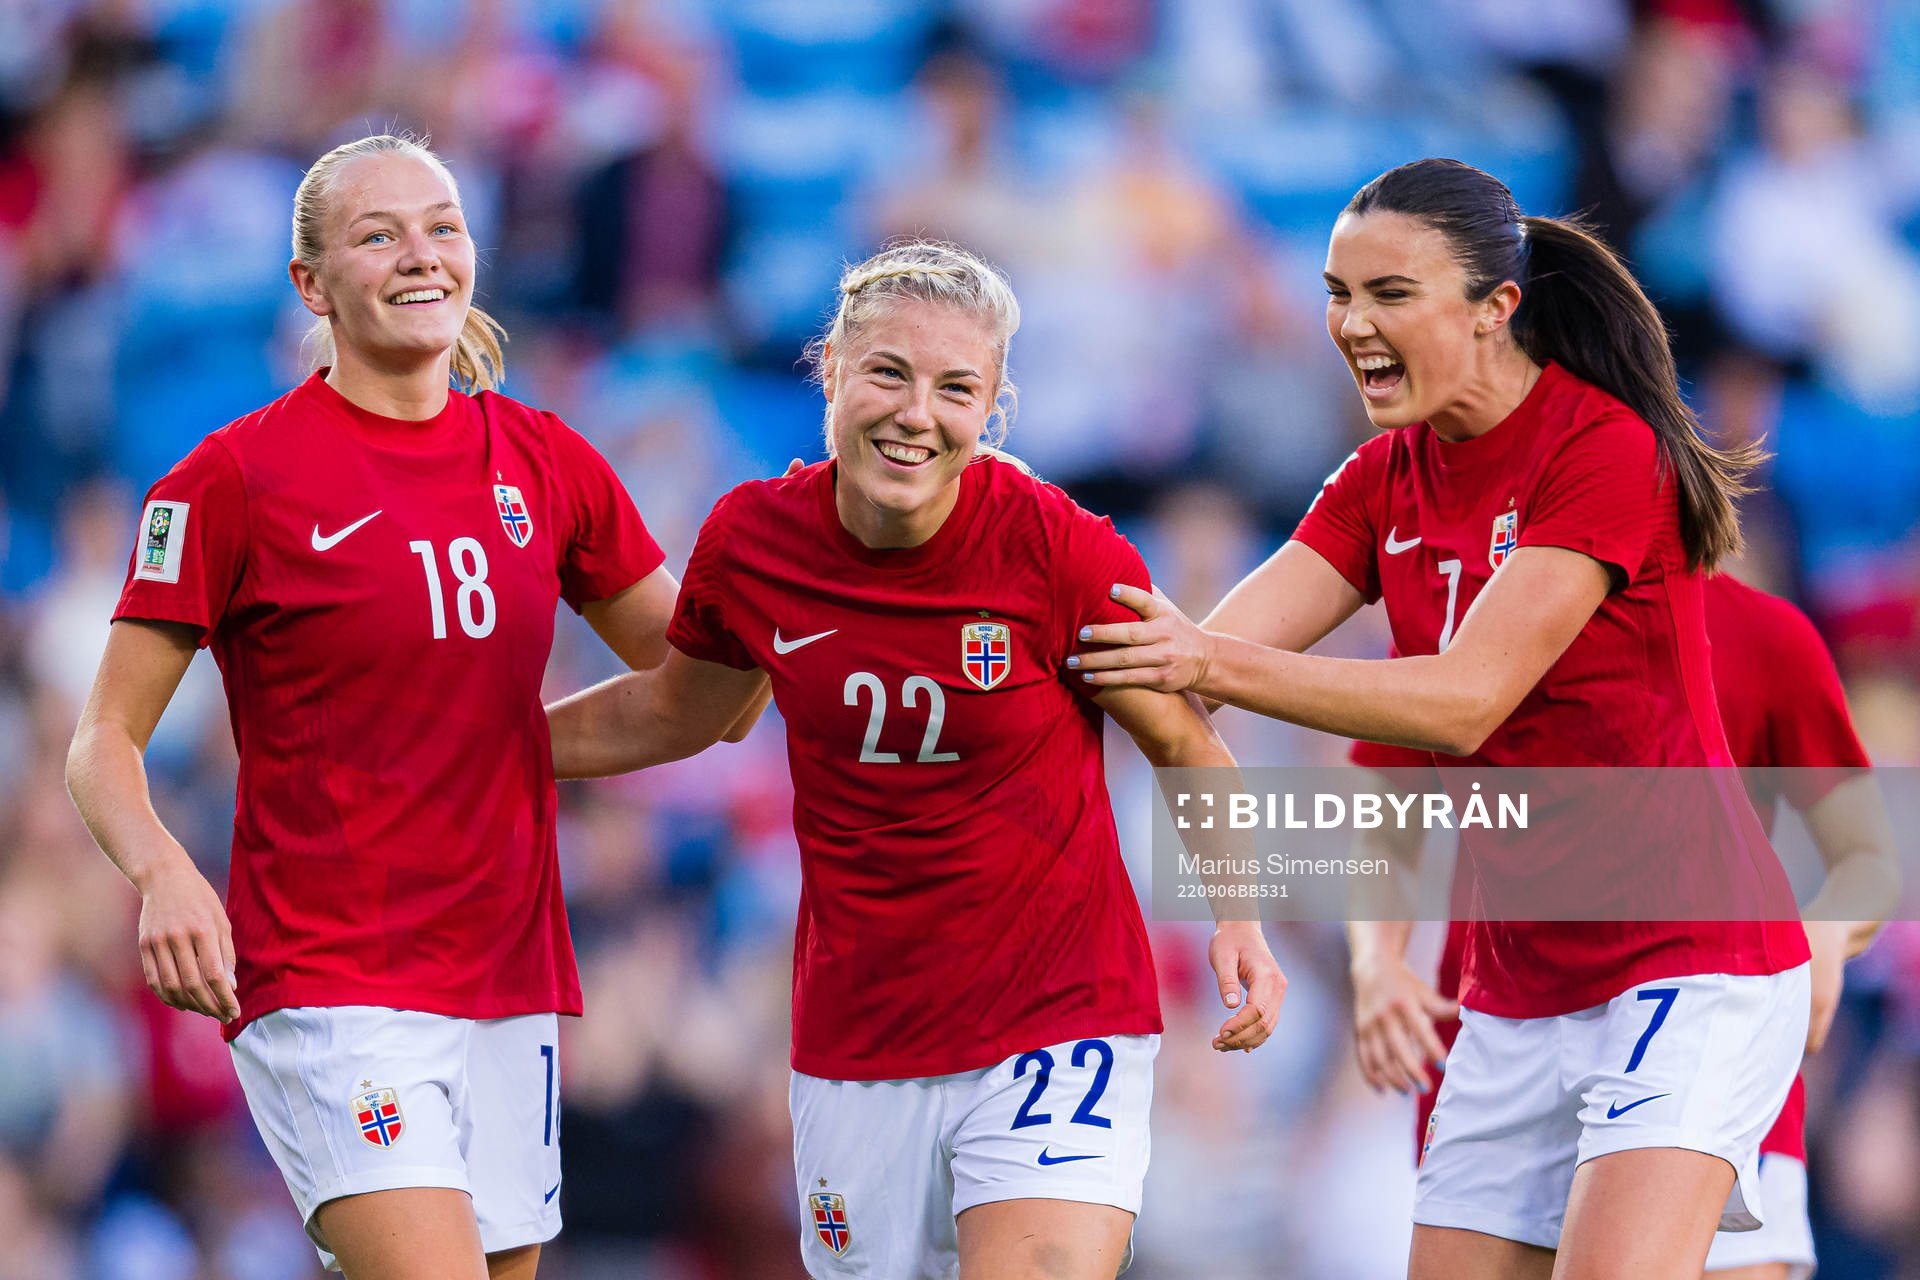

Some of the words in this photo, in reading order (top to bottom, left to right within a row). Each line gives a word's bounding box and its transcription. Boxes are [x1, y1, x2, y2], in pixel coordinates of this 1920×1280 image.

[409, 537, 497, 639] 18
[1438, 559, 1462, 655] 7
[843, 671, 960, 763] 22
[1624, 988, 1680, 1074] 7
[1009, 1039, 1114, 1131] 22
